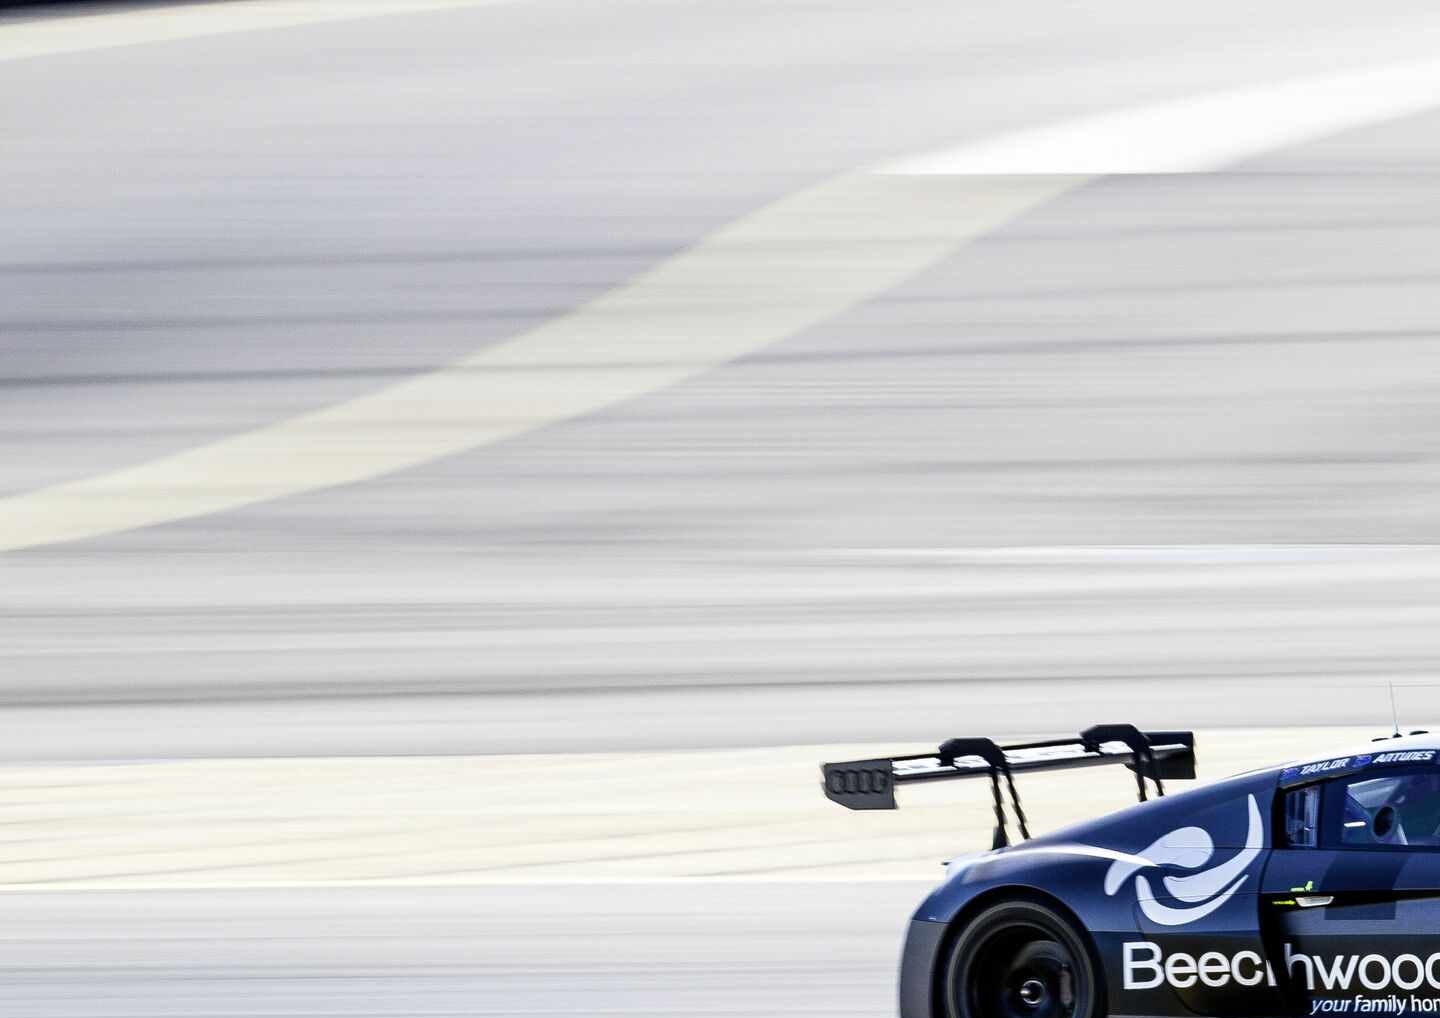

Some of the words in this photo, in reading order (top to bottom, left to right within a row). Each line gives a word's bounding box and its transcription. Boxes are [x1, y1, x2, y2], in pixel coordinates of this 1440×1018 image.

[1300, 758, 1350, 775] TAYLOR
[1372, 750, 1437, 763] ANTUNES
[1310, 997, 1352, 1016] your
[1353, 994, 1408, 1016] family
